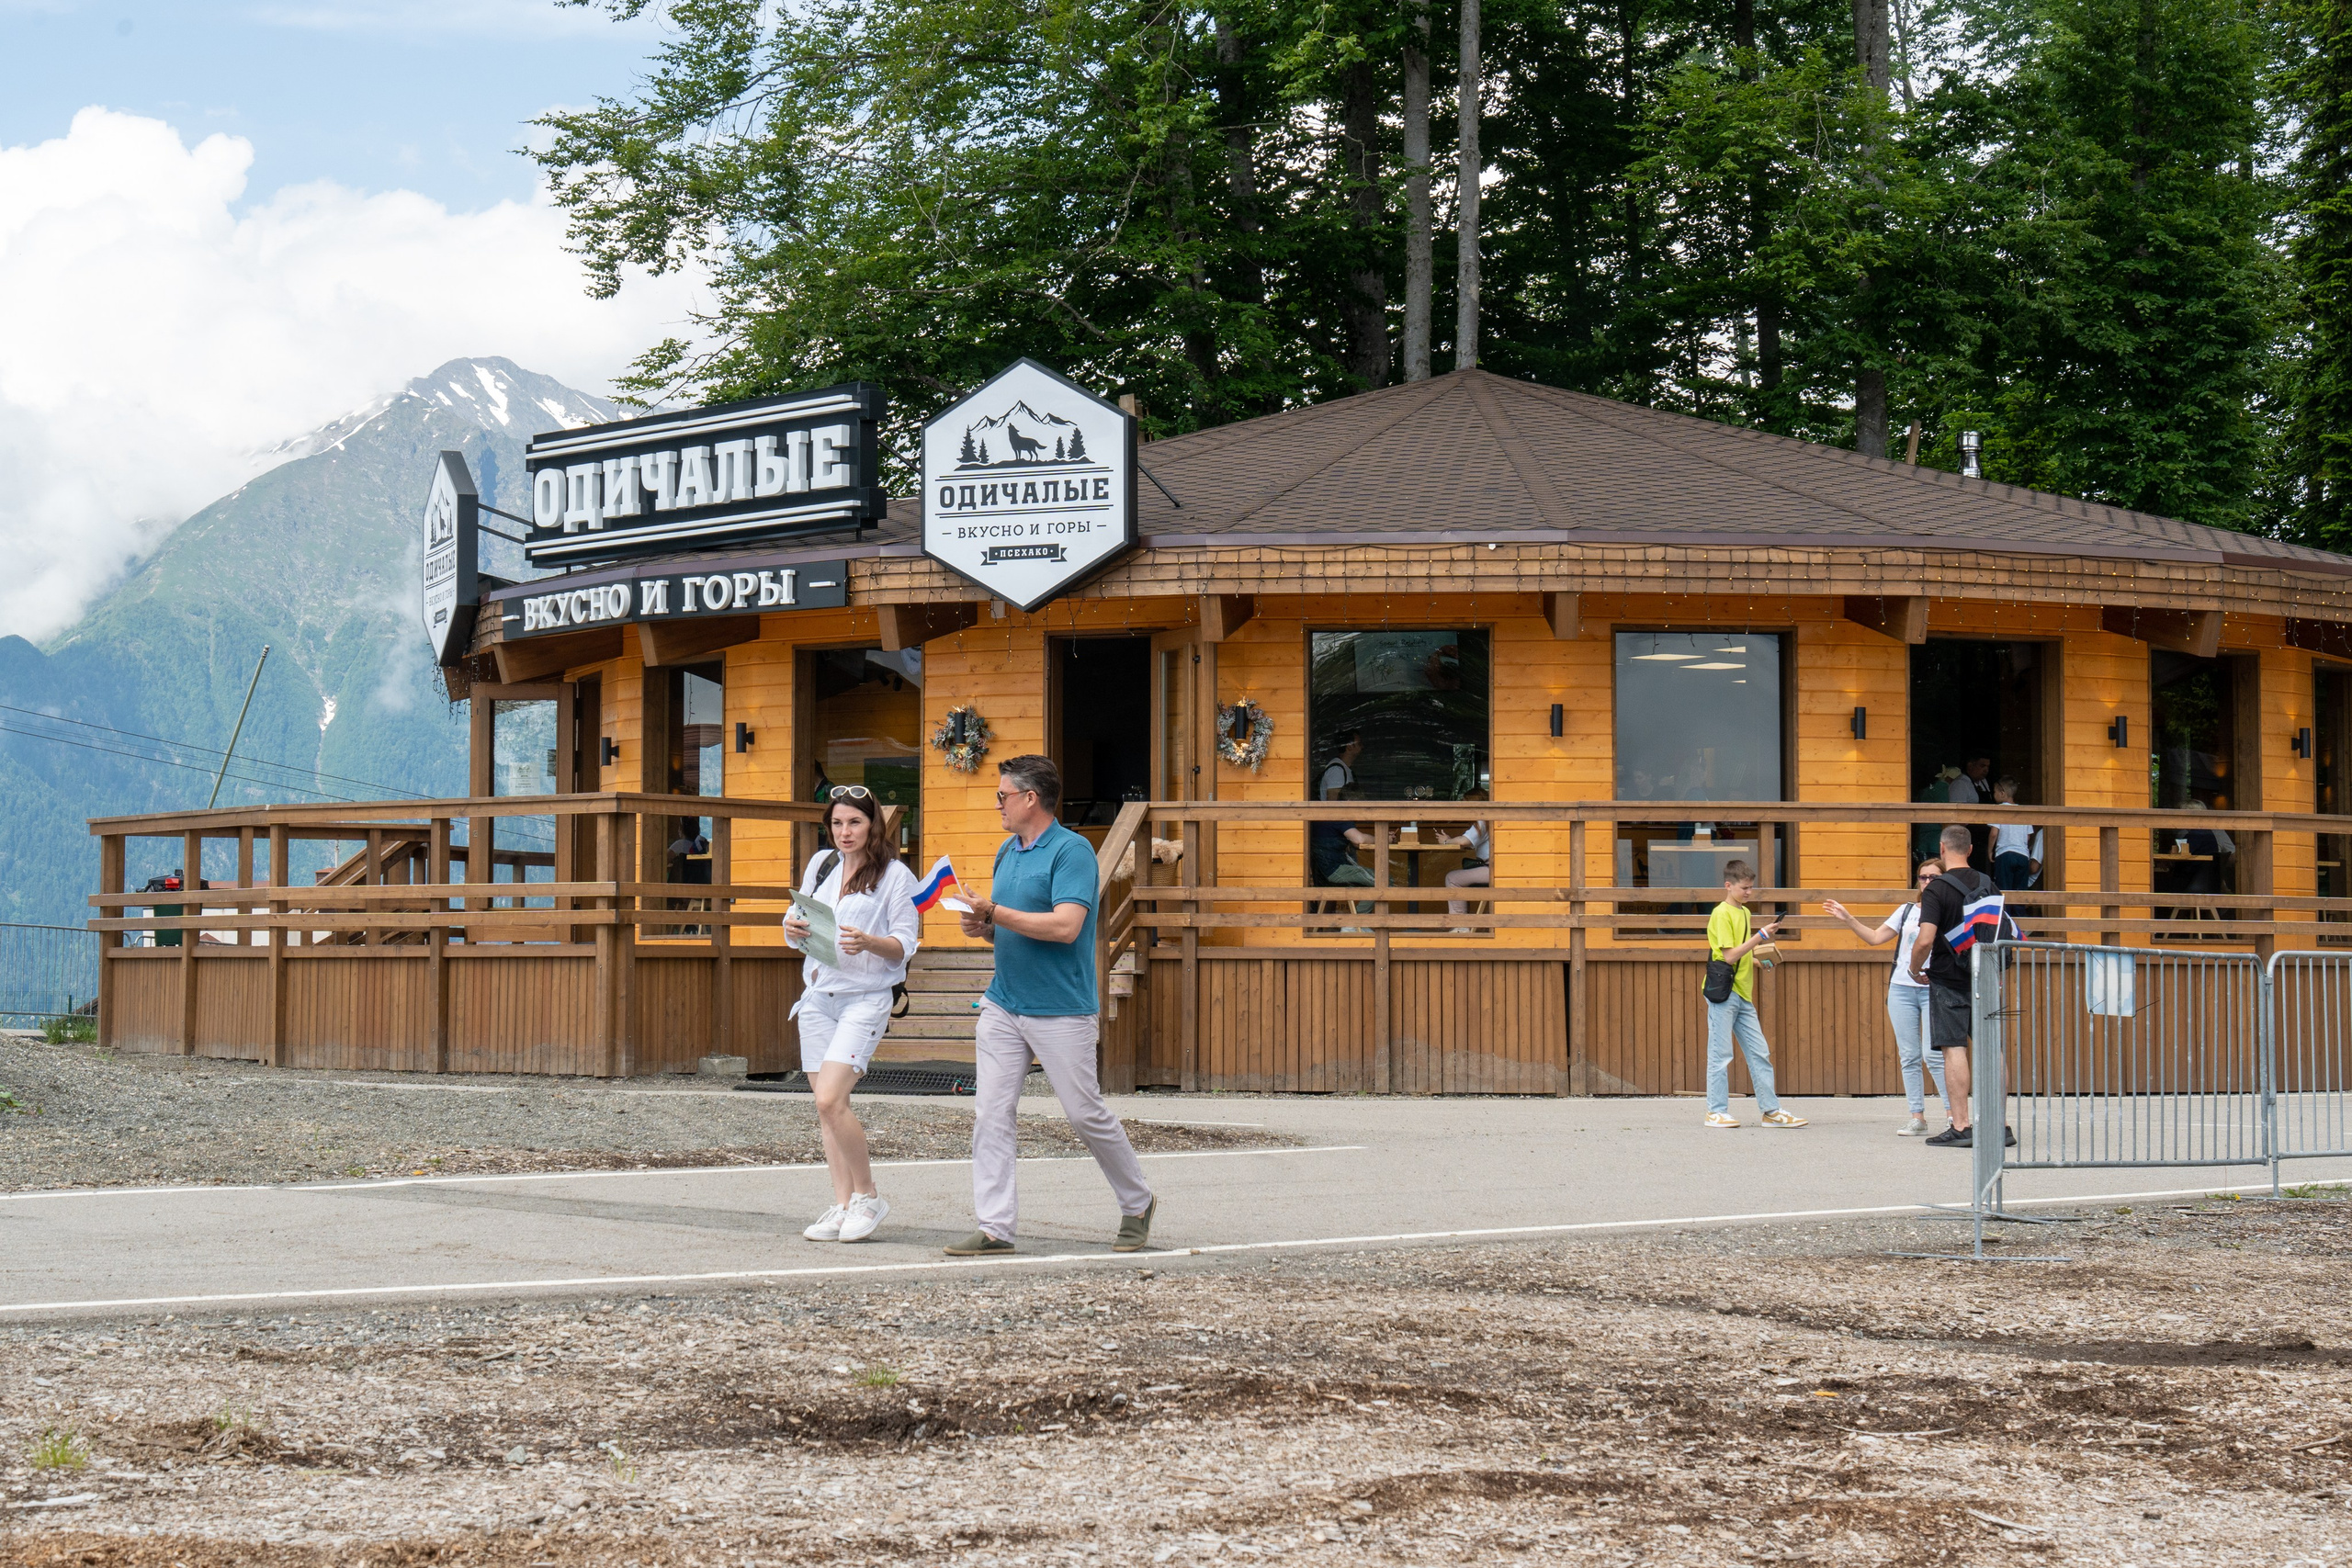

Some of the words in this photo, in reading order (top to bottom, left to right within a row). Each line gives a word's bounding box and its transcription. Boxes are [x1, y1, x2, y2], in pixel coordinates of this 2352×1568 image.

[534, 424, 850, 533] ОДИЧАЛЫЕ
[940, 478, 1109, 511] ОДИЧАЛЫЕ
[958, 525, 1023, 538] ВКУСНО
[1030, 524, 1039, 535] И
[1047, 521, 1091, 535] ГОРЫ
[1000, 547, 1048, 558] ПСЕХАКО
[524, 584, 631, 631] ВКУСНО
[640, 580, 669, 615] И
[682, 570, 796, 613] ГОРЫ
